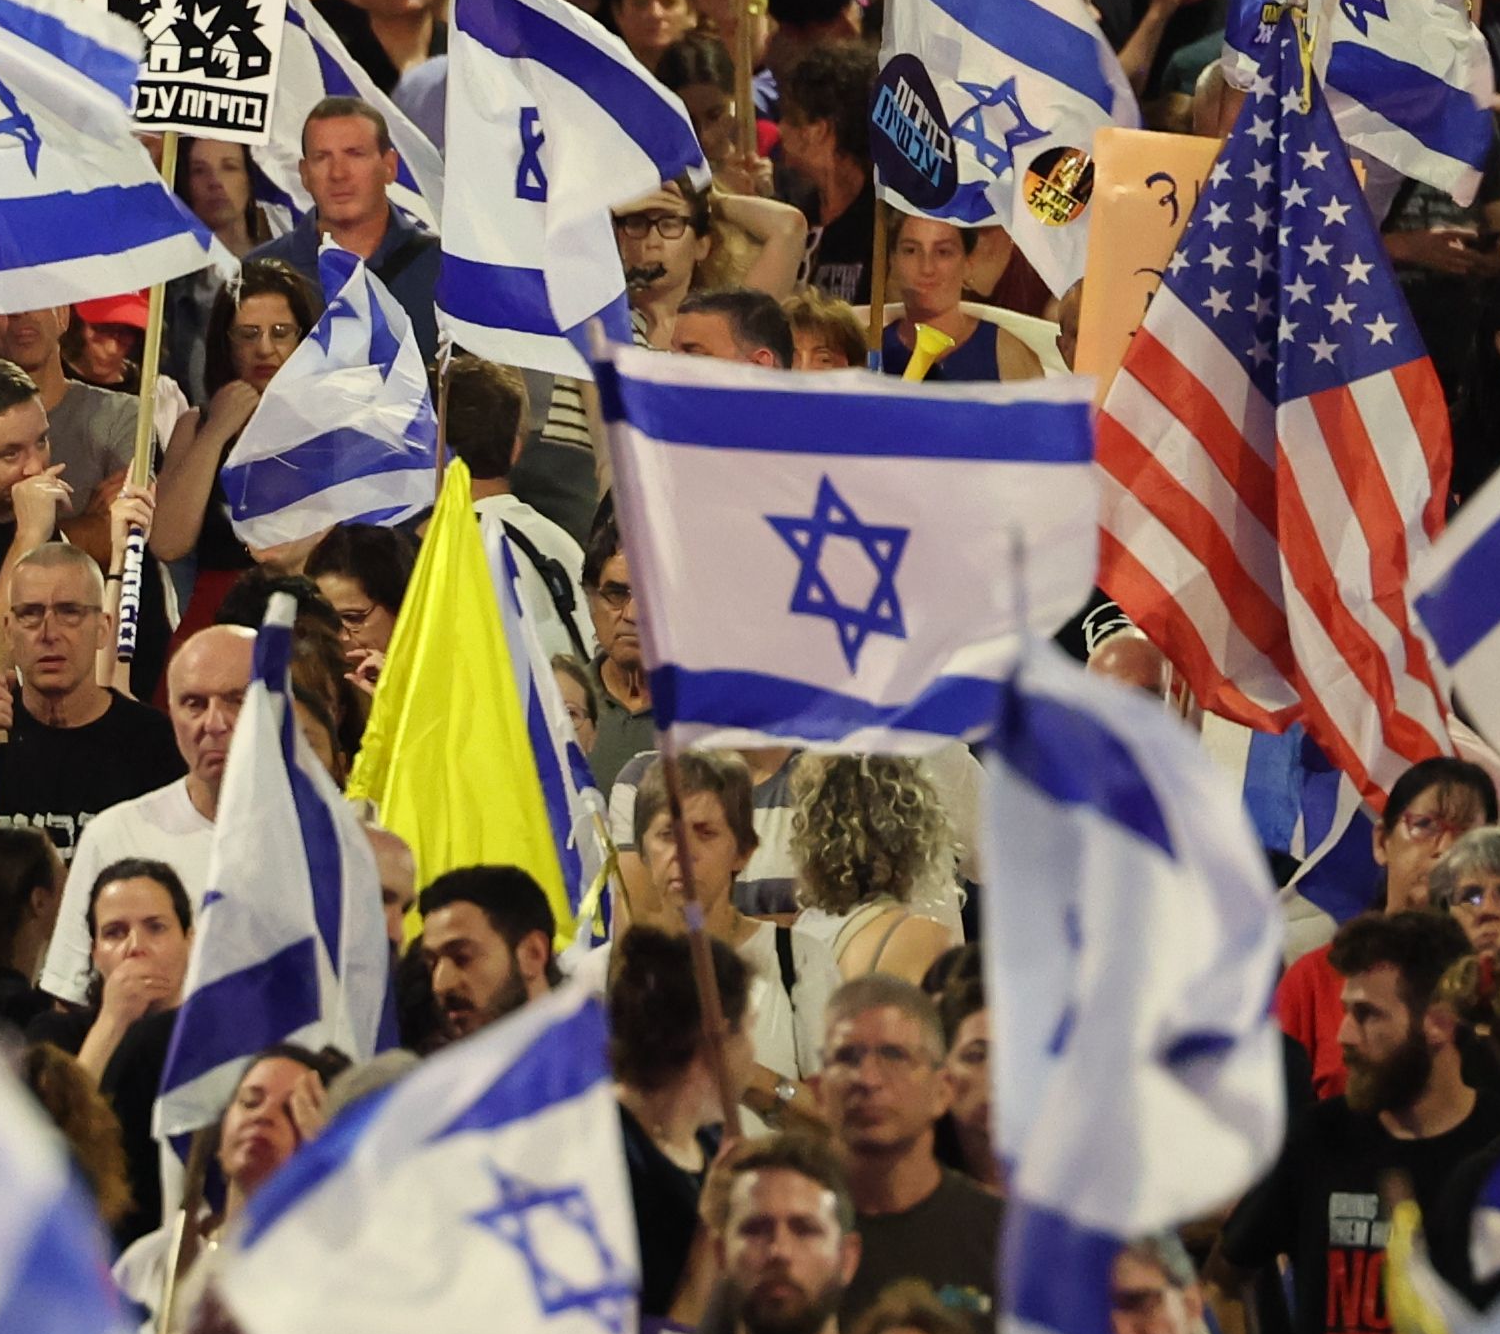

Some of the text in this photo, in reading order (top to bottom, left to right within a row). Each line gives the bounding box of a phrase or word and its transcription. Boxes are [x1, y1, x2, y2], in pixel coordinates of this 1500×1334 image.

[179, 87, 263, 128] בחירות
[895, 76, 952, 164] בחירות
[1326, 1250, 1394, 1329] NO
